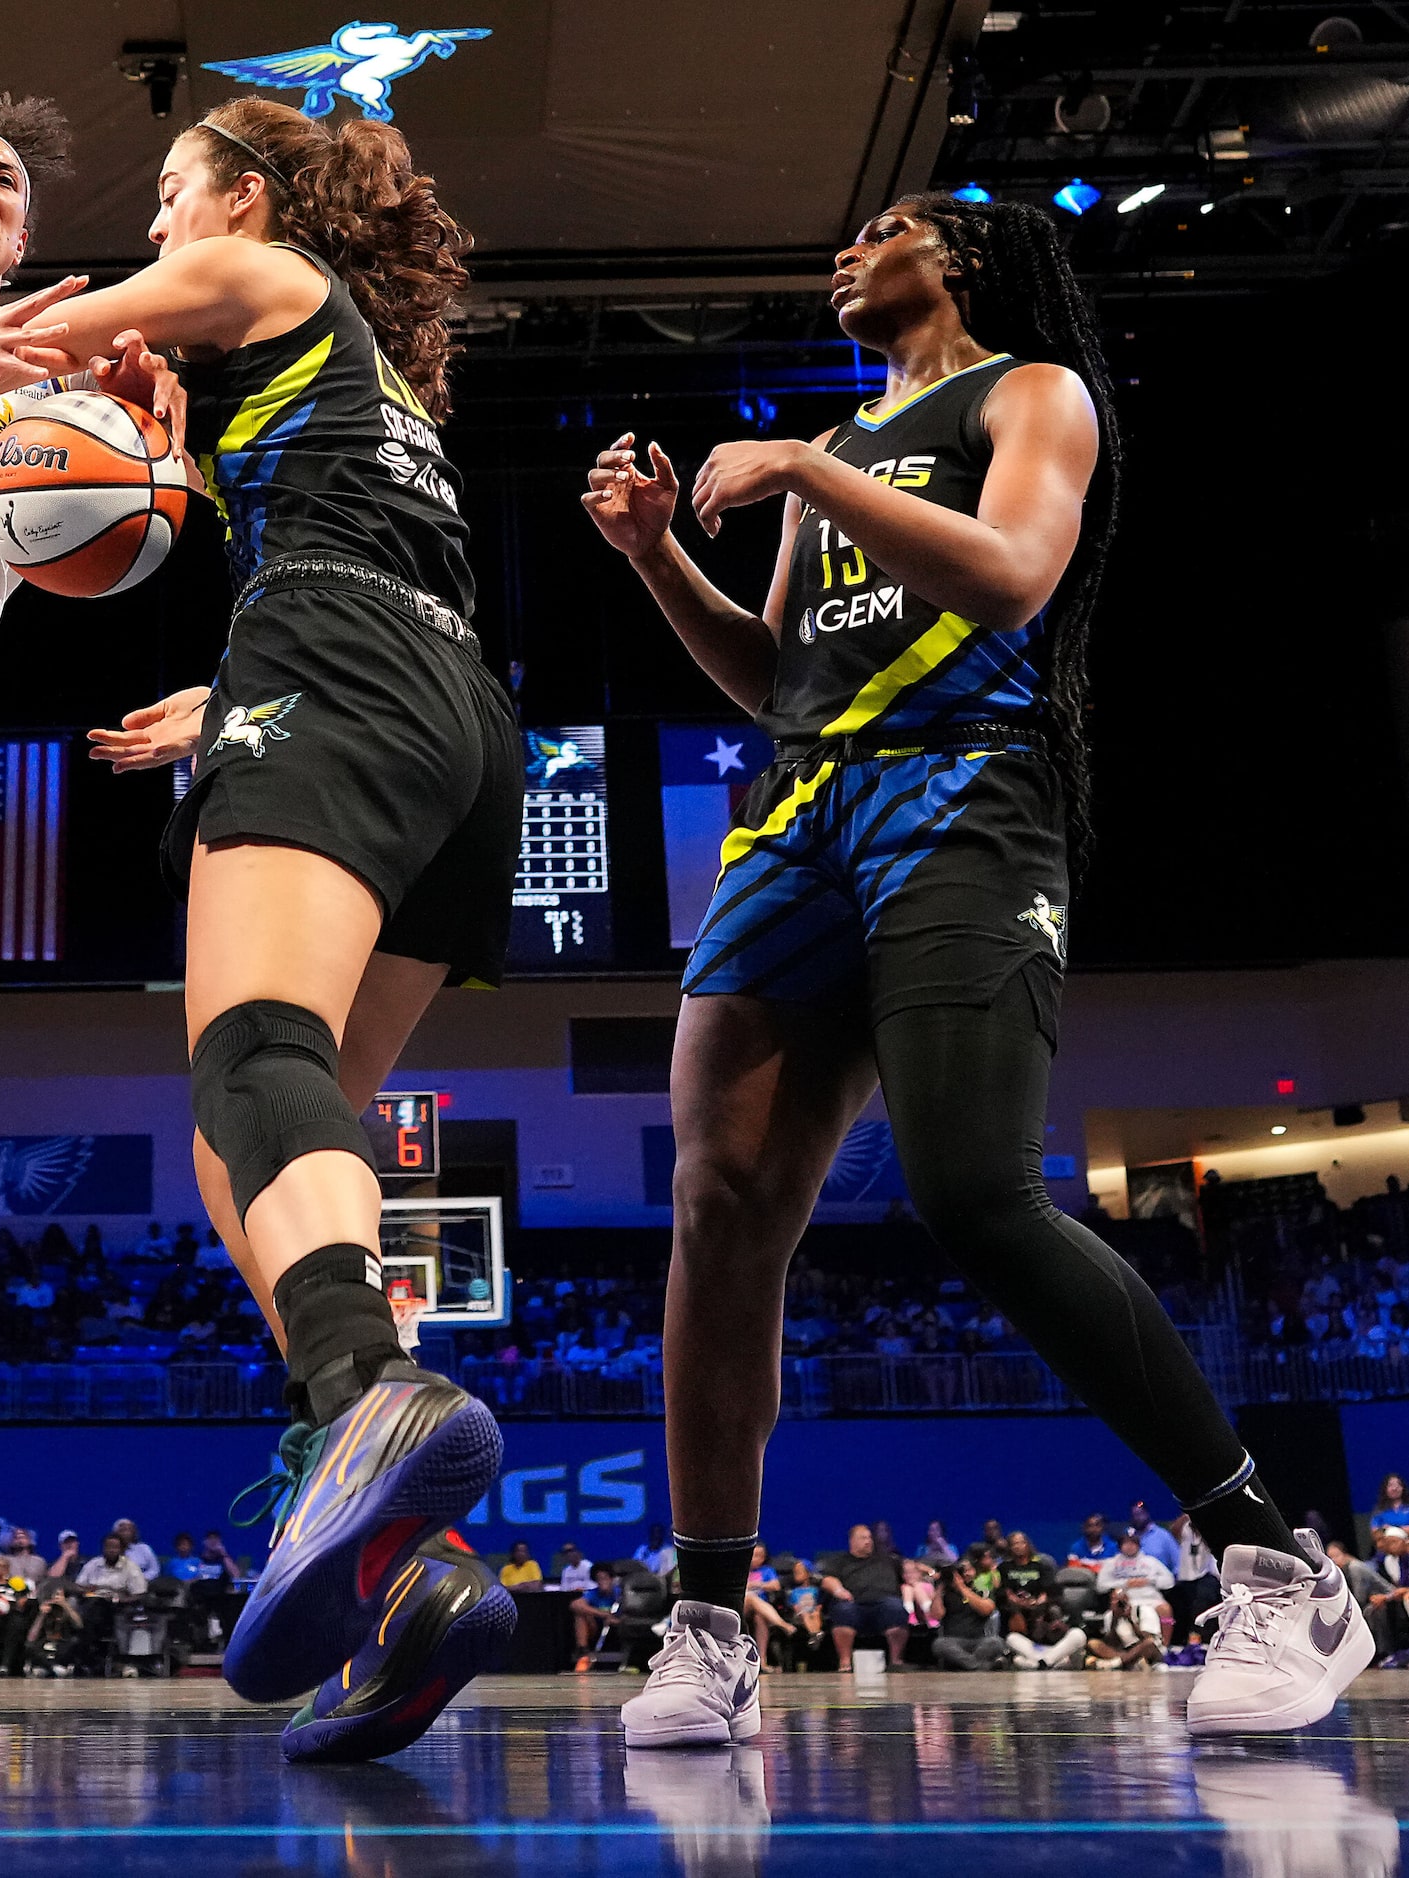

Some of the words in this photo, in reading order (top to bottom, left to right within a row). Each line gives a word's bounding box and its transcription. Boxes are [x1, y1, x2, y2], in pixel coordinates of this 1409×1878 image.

[818, 518, 867, 589] 15
[815, 584, 904, 632] GEM
[397, 1126, 423, 1167] 6
